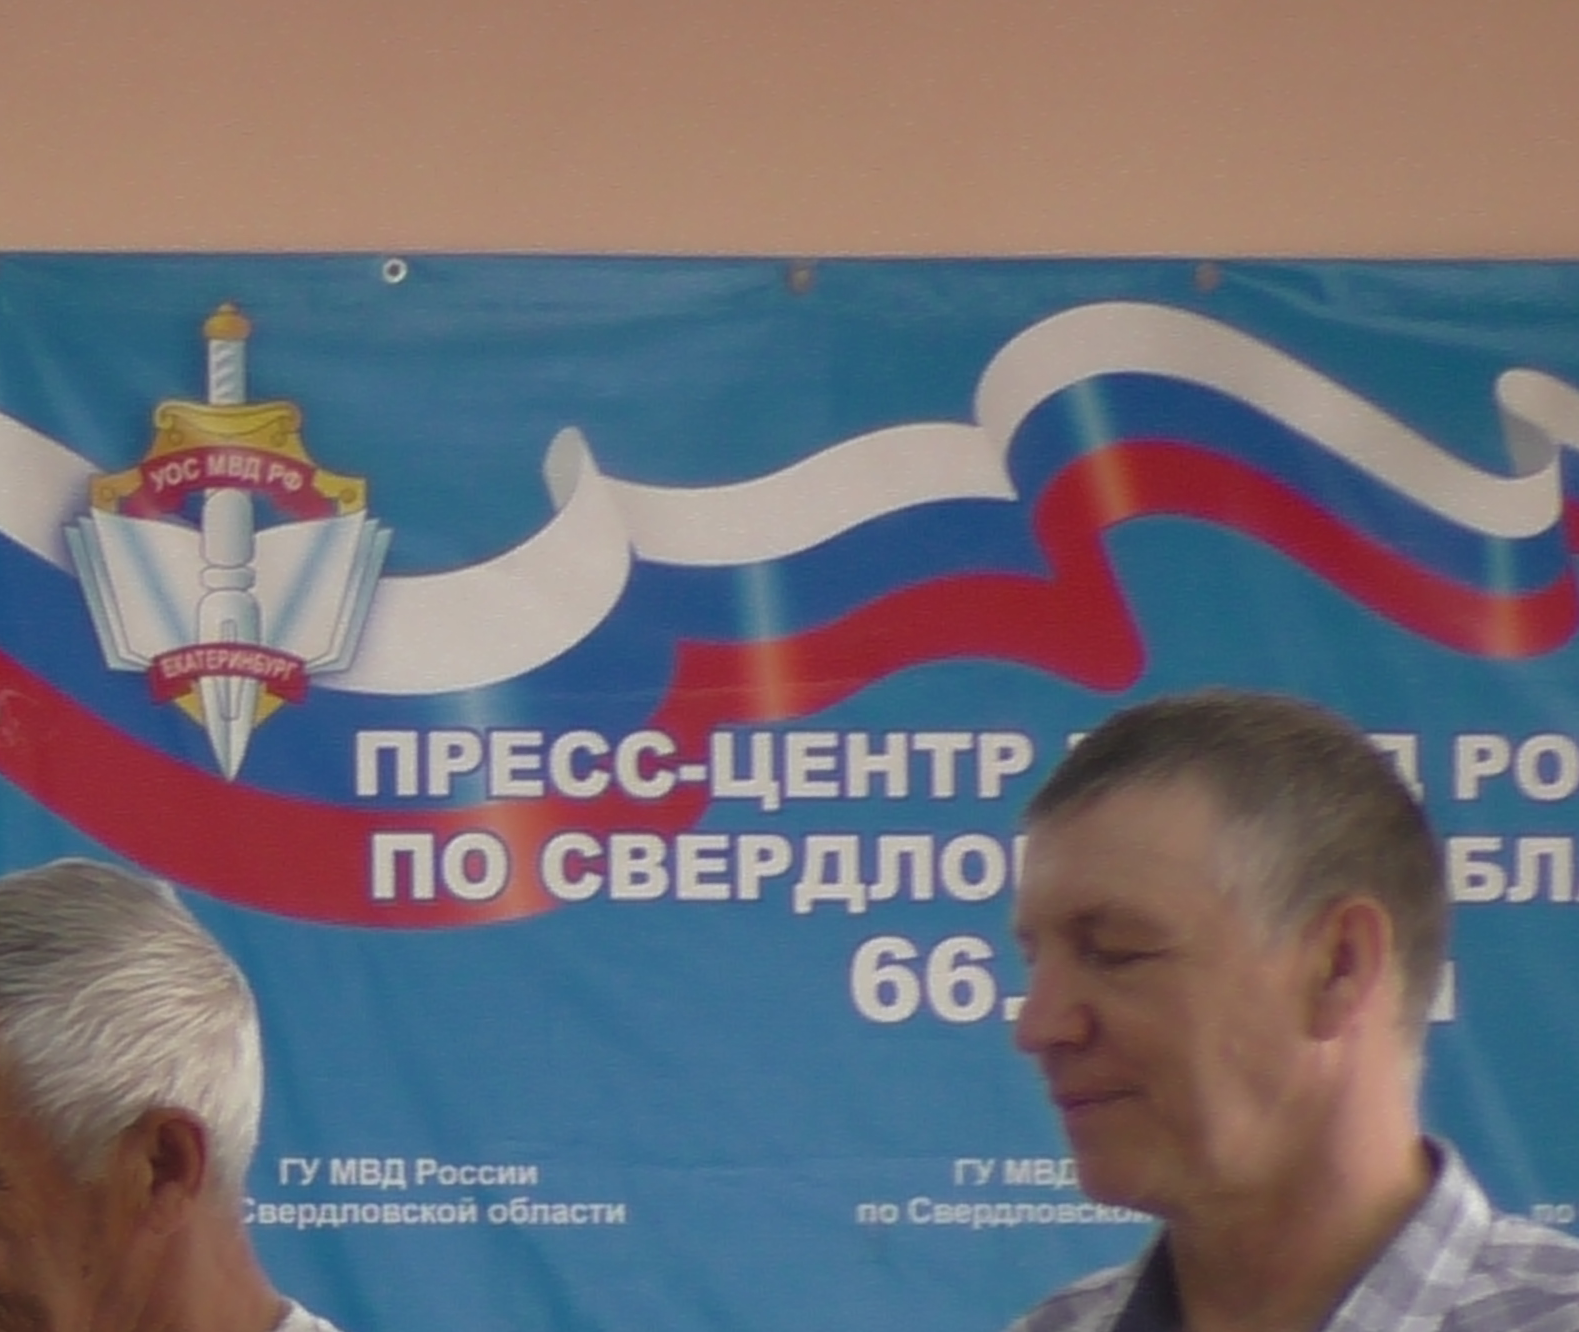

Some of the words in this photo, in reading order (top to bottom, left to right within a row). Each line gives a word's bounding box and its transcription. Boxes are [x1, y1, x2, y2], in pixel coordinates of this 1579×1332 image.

[150, 458, 200, 492] УОС
[207, 455, 262, 483] МВД
[266, 463, 304, 491] РФ
[160, 650, 299, 680] ЕКАТЕРИНБУРГ
[354, 730, 1034, 811] ПРЕСС-ЦЕНТР
[371, 831, 509, 900] ПО
[541, 831, 1027, 914] СВЕРДЛО
[1446, 836, 1579, 902] БЛ
[279, 1157, 321, 1186] ГУ
[330, 1157, 408, 1190] МВД
[415, 1157, 539, 1186] России
[953, 1157, 995, 1187] ГУ
[487, 1196, 627, 1225] области
[855, 1203, 900, 1225] по
